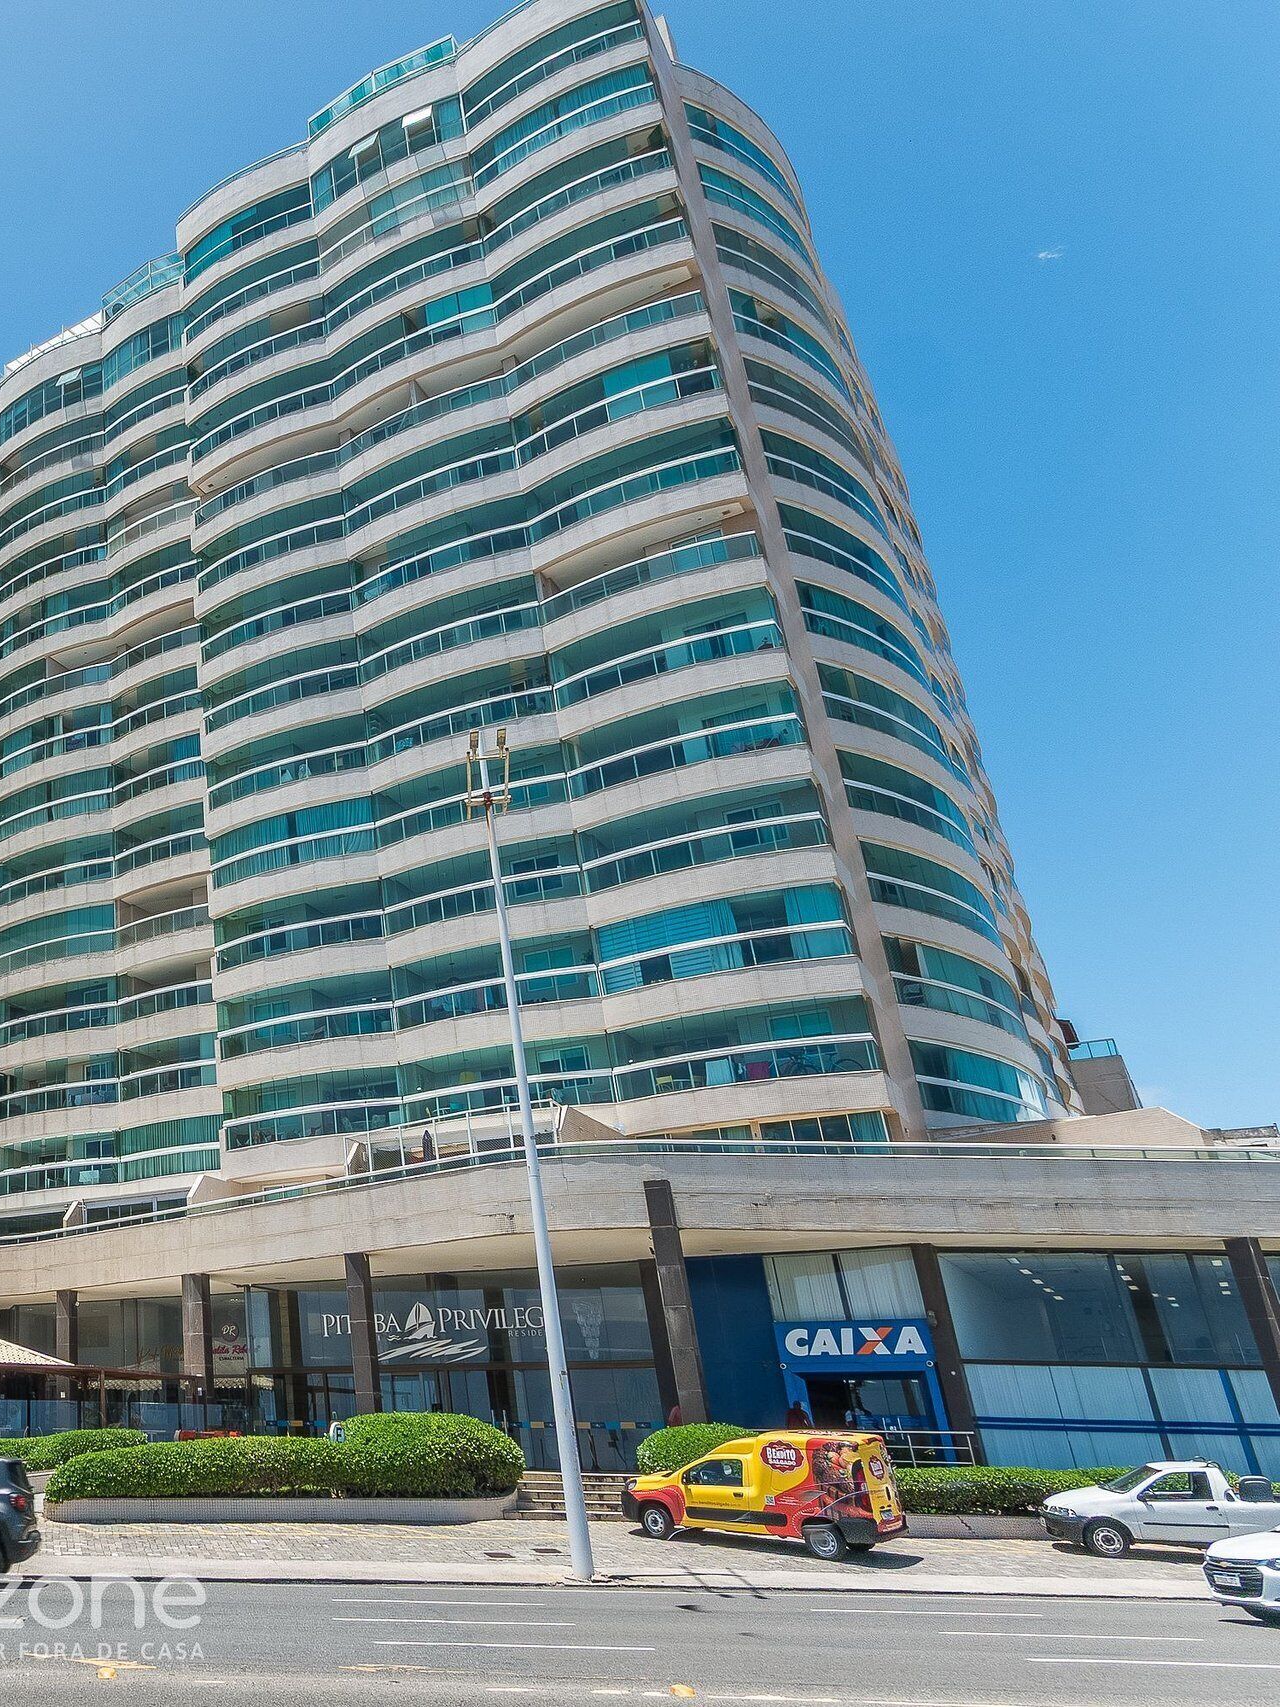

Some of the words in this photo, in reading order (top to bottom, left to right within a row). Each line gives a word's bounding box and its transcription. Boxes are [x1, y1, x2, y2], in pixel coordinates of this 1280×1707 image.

[322, 1312, 402, 1337] PITBA
[437, 1307, 544, 1333] PRIVILEG
[508, 1329, 543, 1337] RESIDE
[785, 1326, 928, 1357] CAIXA
